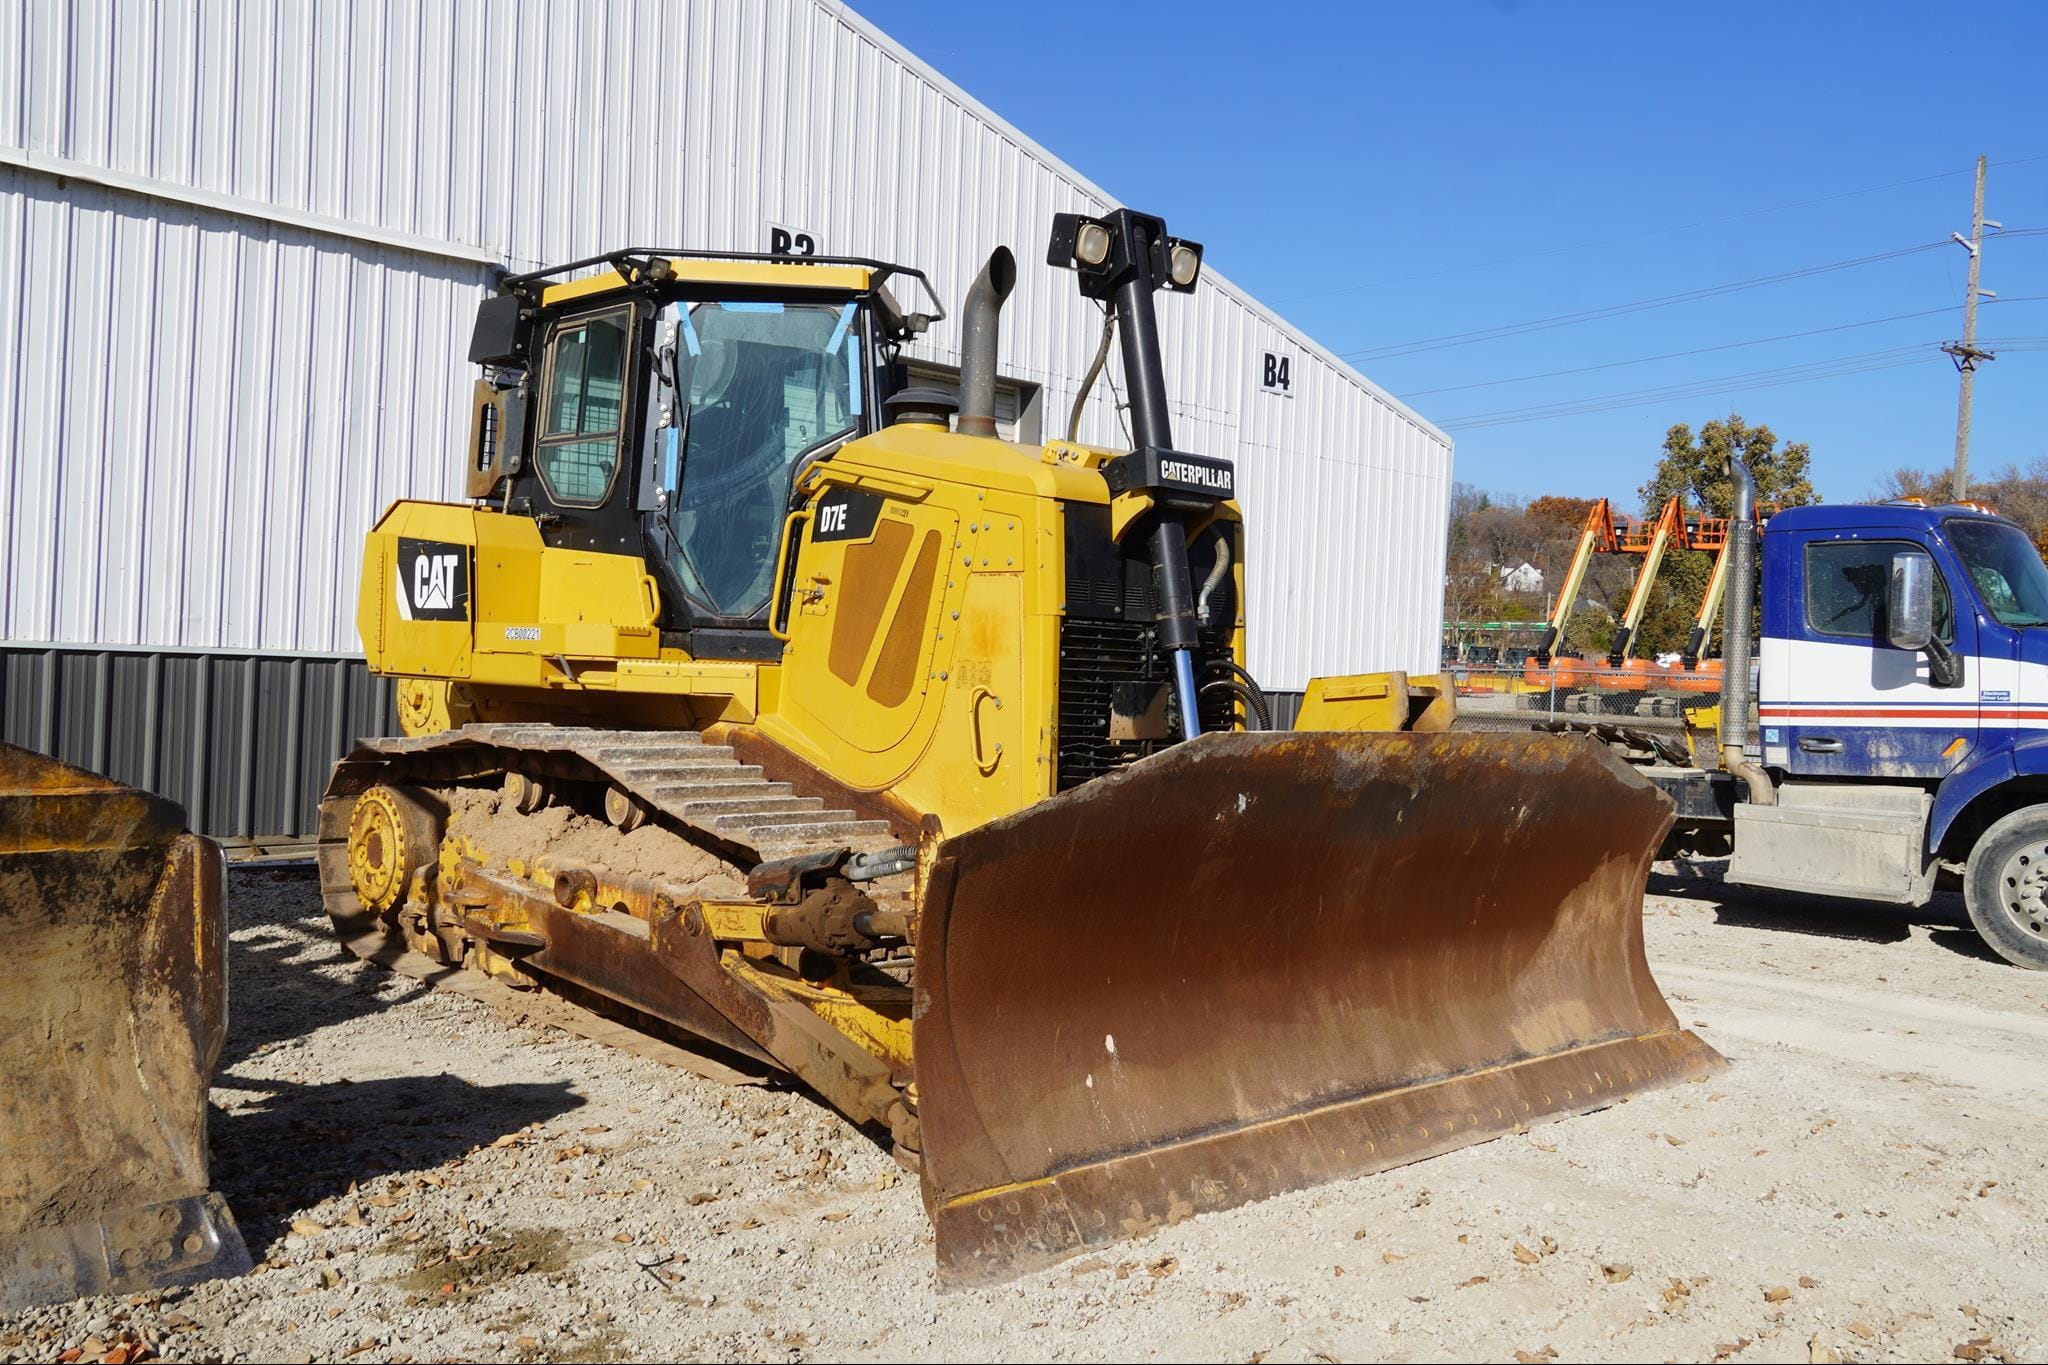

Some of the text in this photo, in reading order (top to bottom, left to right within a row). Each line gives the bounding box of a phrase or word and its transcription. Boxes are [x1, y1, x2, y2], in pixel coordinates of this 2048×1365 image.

[1263, 352, 1290, 391] B4
[1161, 459, 1232, 490] CATERPILLAR
[820, 503, 848, 533] D7E
[414, 554, 459, 609] CAT
